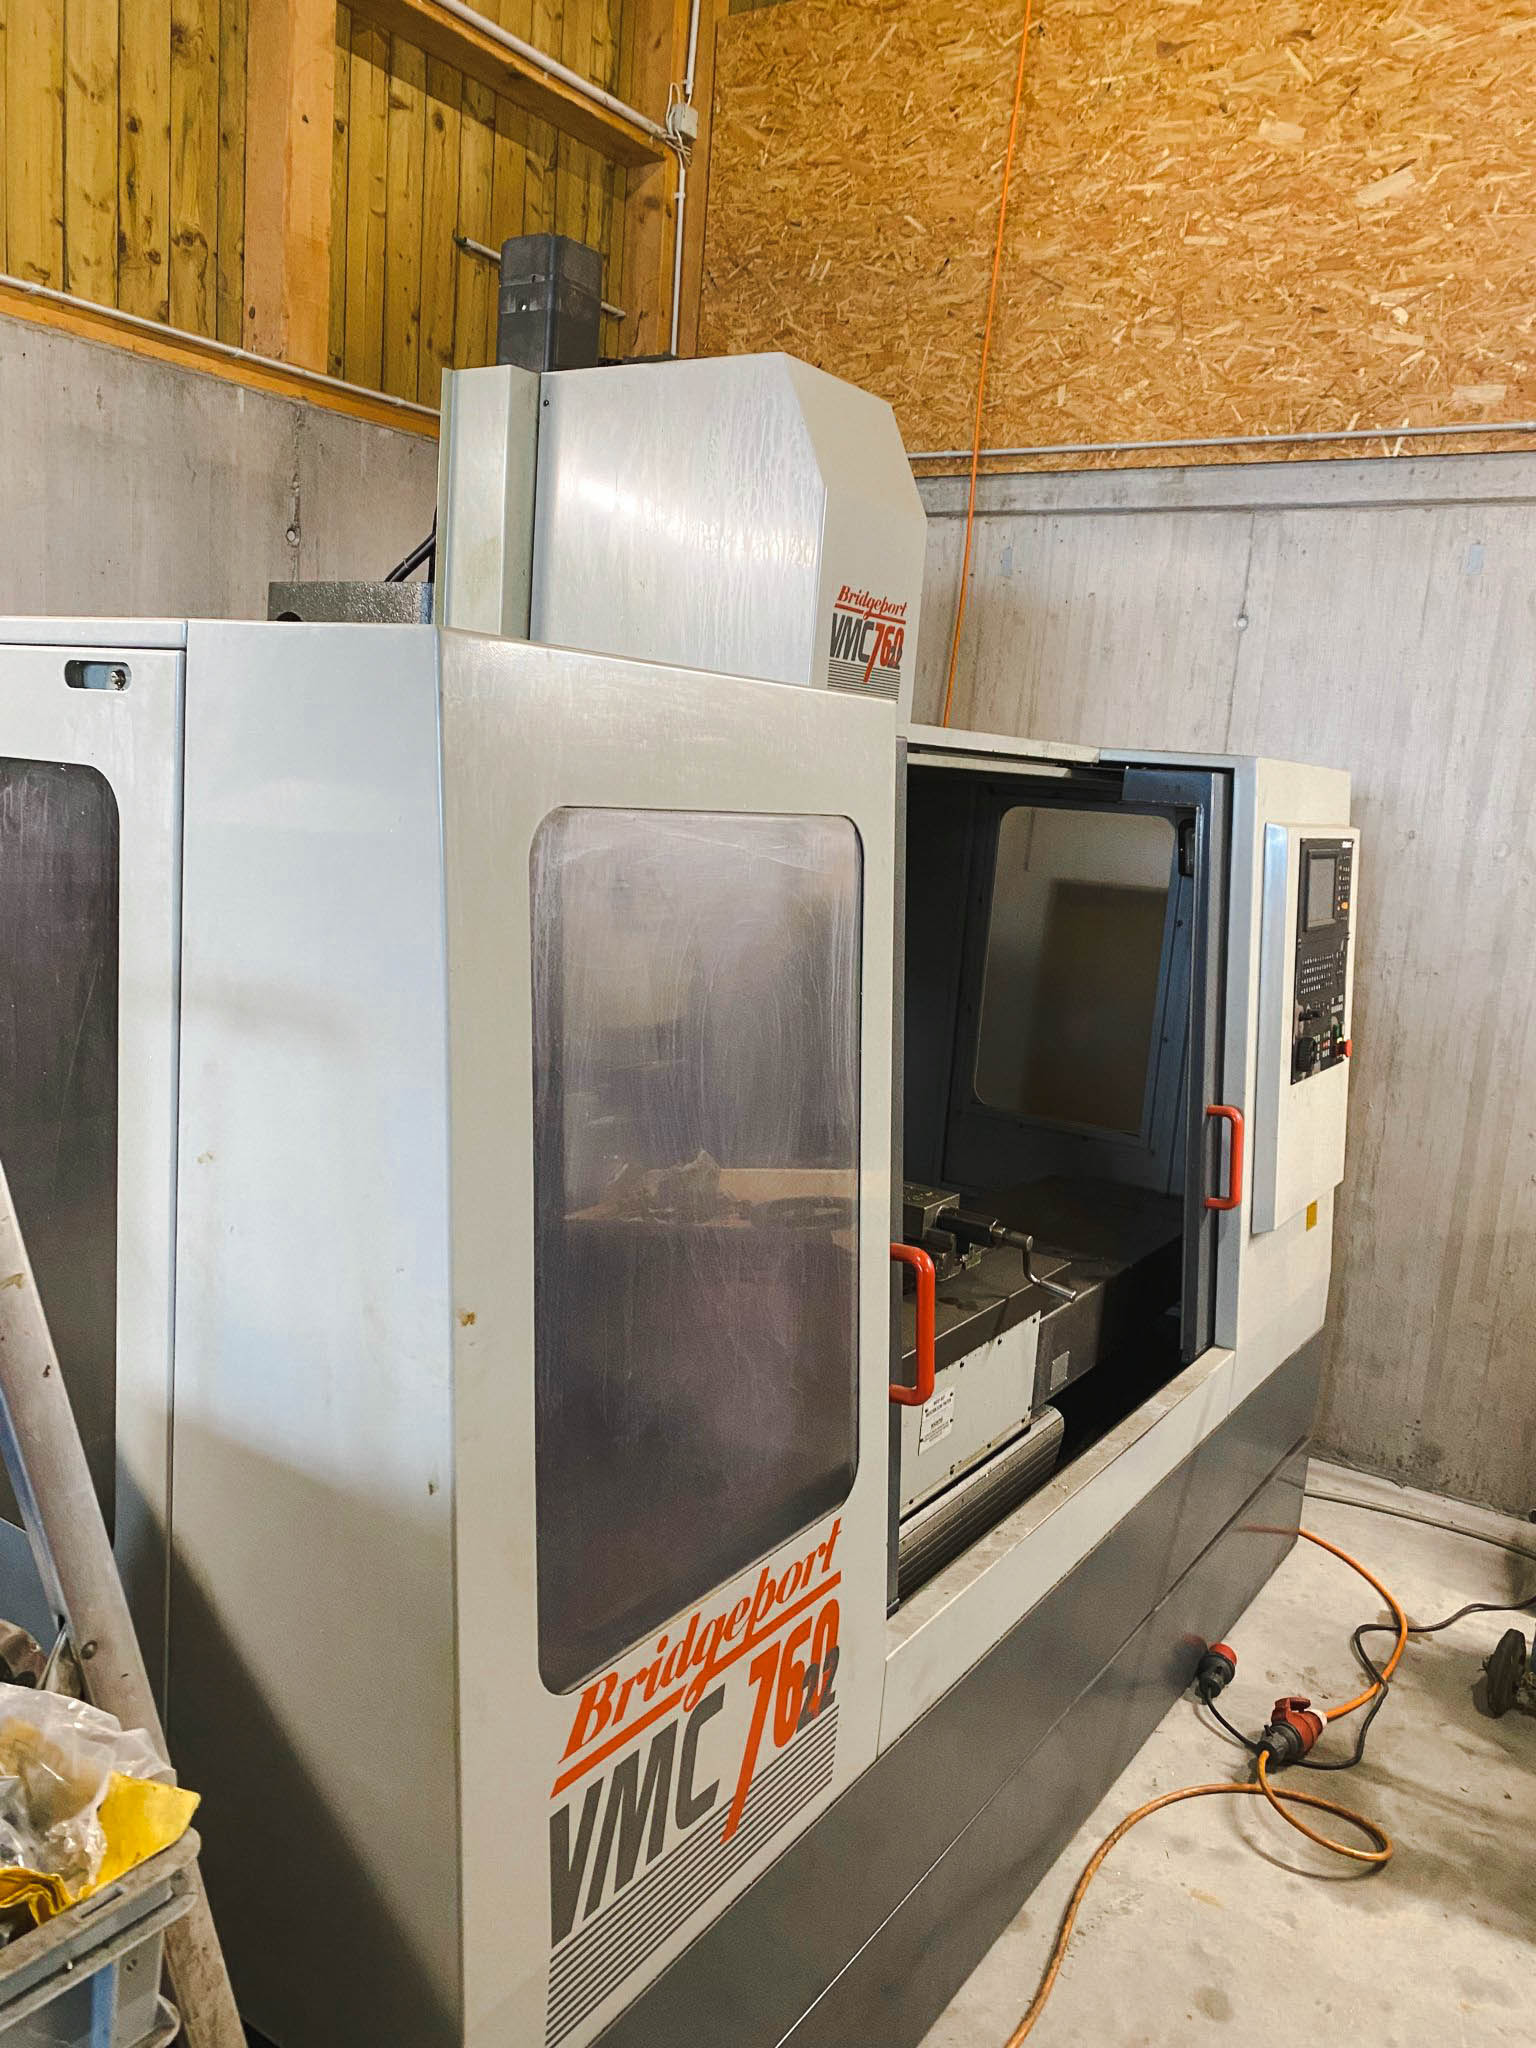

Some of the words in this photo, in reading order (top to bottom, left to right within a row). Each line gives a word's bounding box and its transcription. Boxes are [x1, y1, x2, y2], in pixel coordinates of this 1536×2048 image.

[837, 585, 907, 620] Bridgeport
[558, 1517, 842, 1765] Bridgeport
[549, 1683, 726, 1949] VMC
